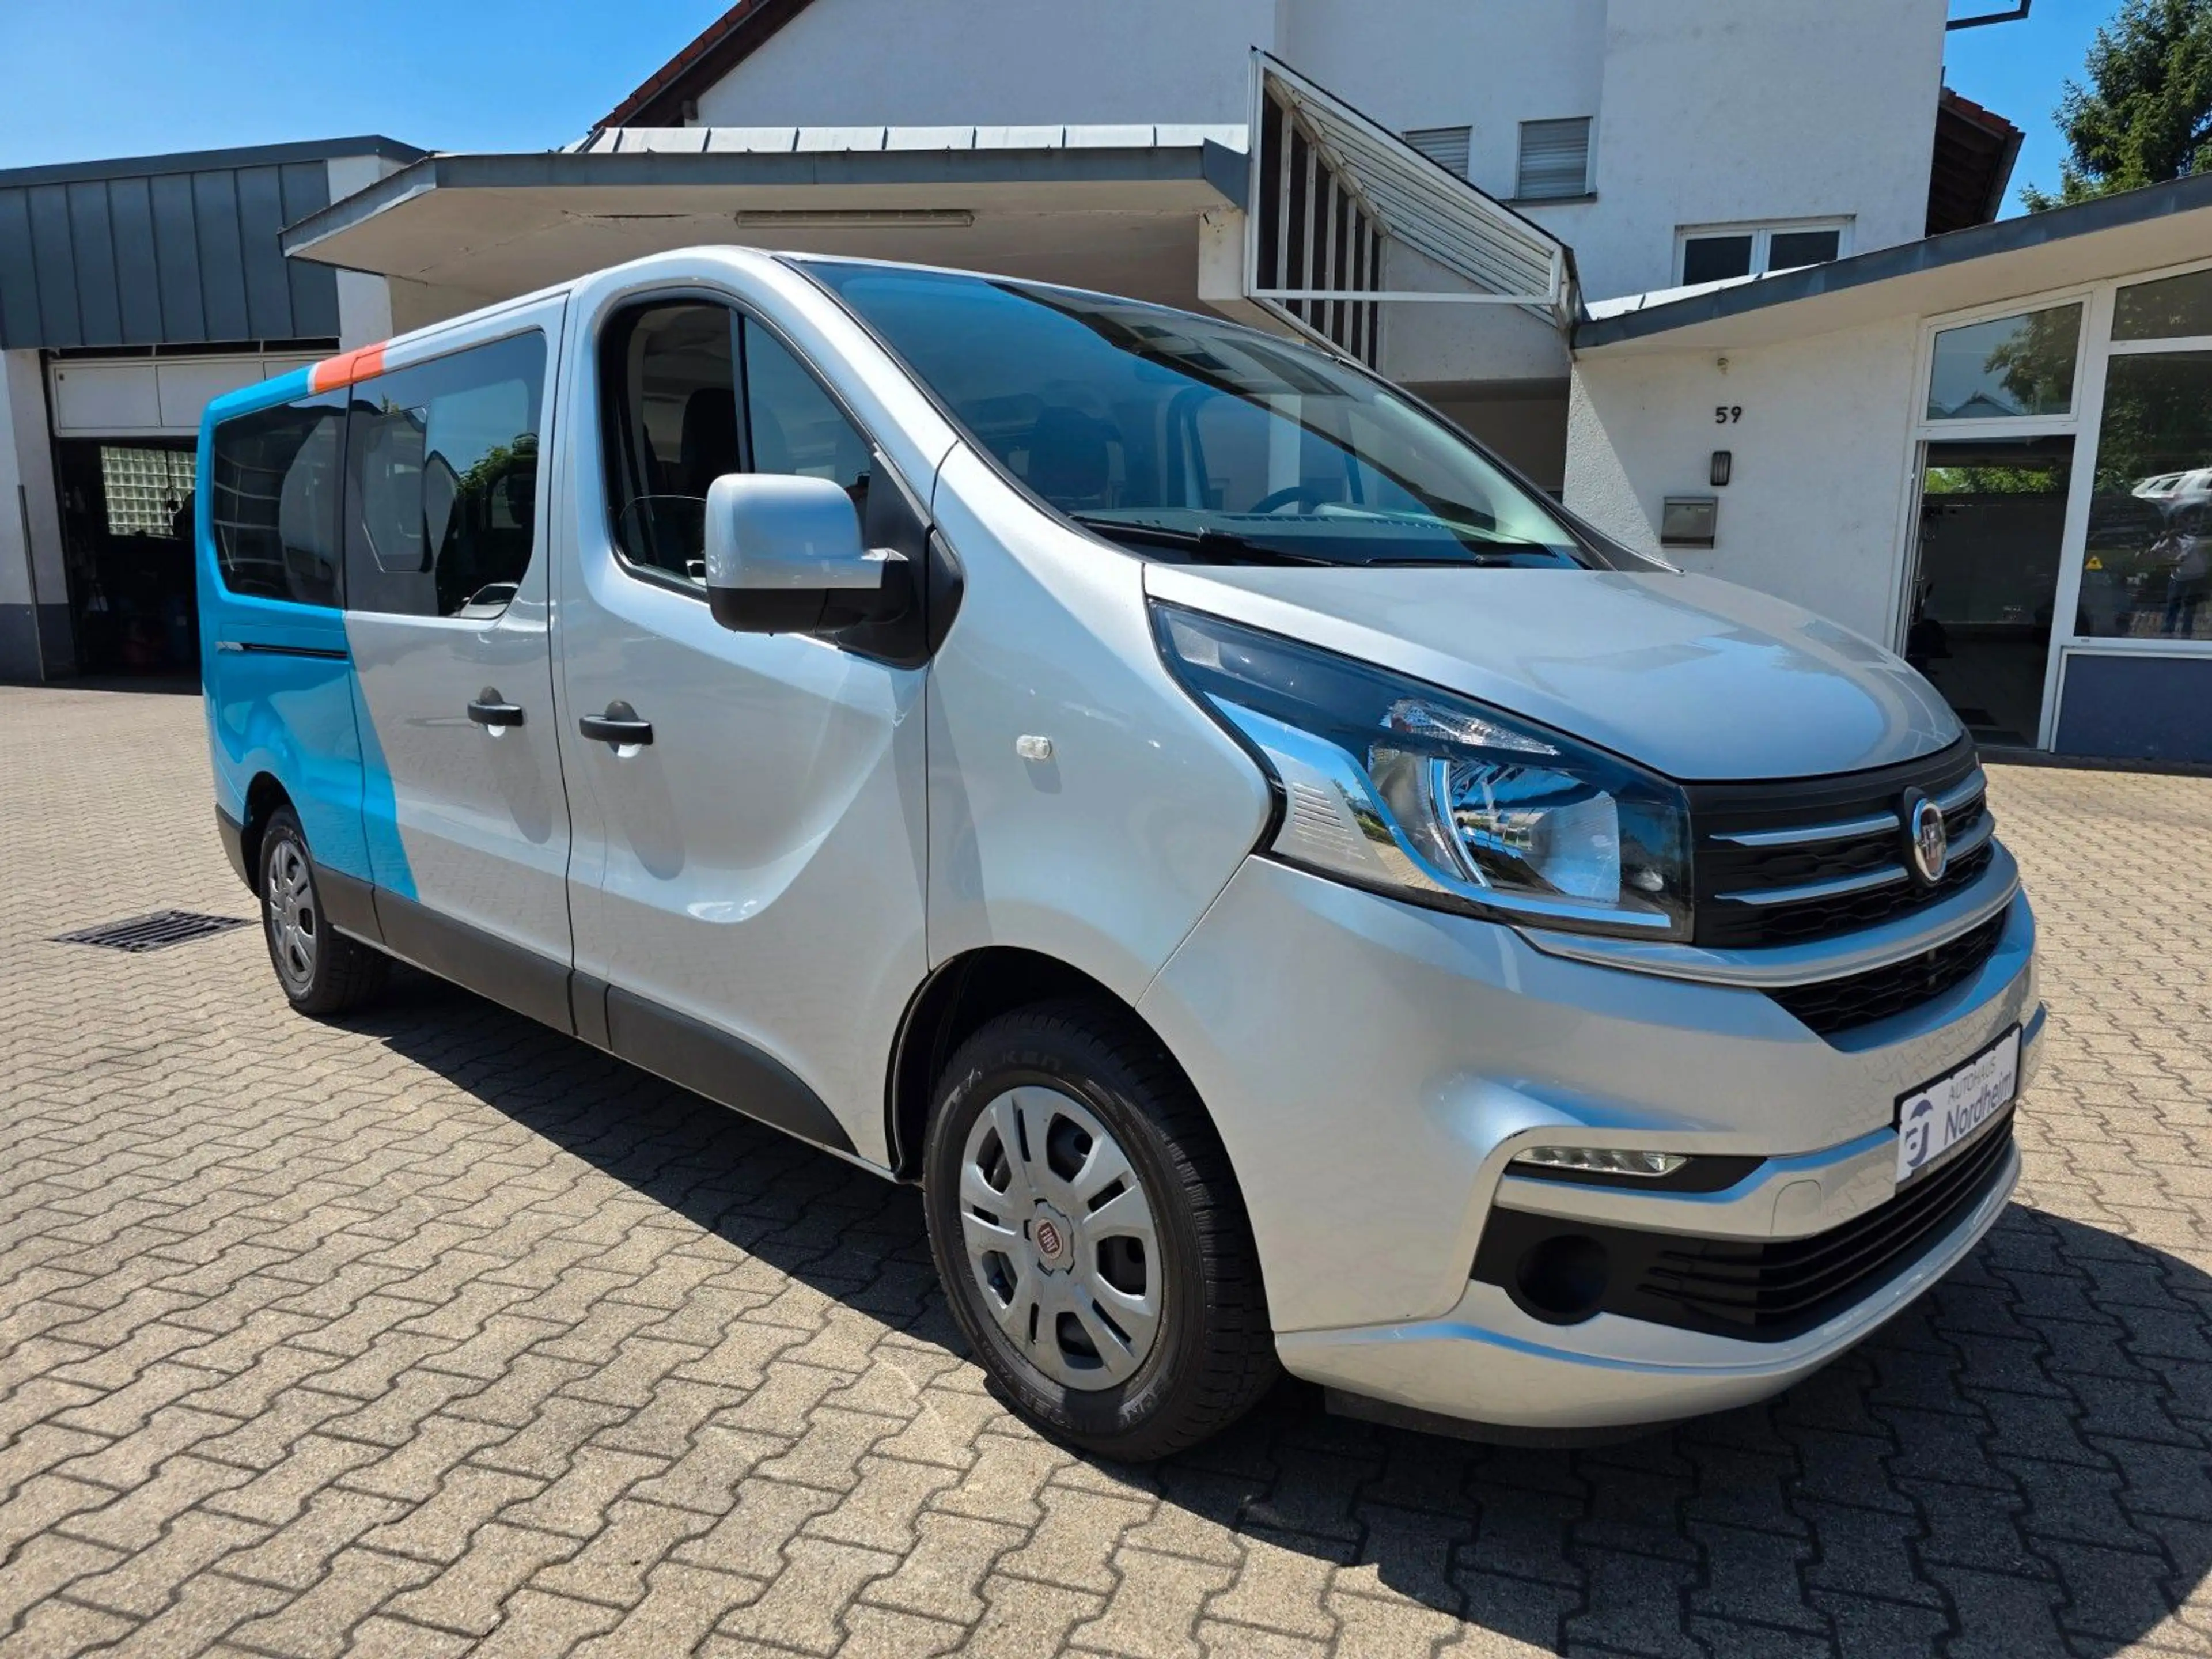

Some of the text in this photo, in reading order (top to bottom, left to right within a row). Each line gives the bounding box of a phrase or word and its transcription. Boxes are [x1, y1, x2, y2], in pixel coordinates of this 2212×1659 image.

[1715, 406, 1742, 424] 59
[1944, 1070, 2012, 1146] Nordheim
[1039, 1226, 1059, 1252] FIAT
